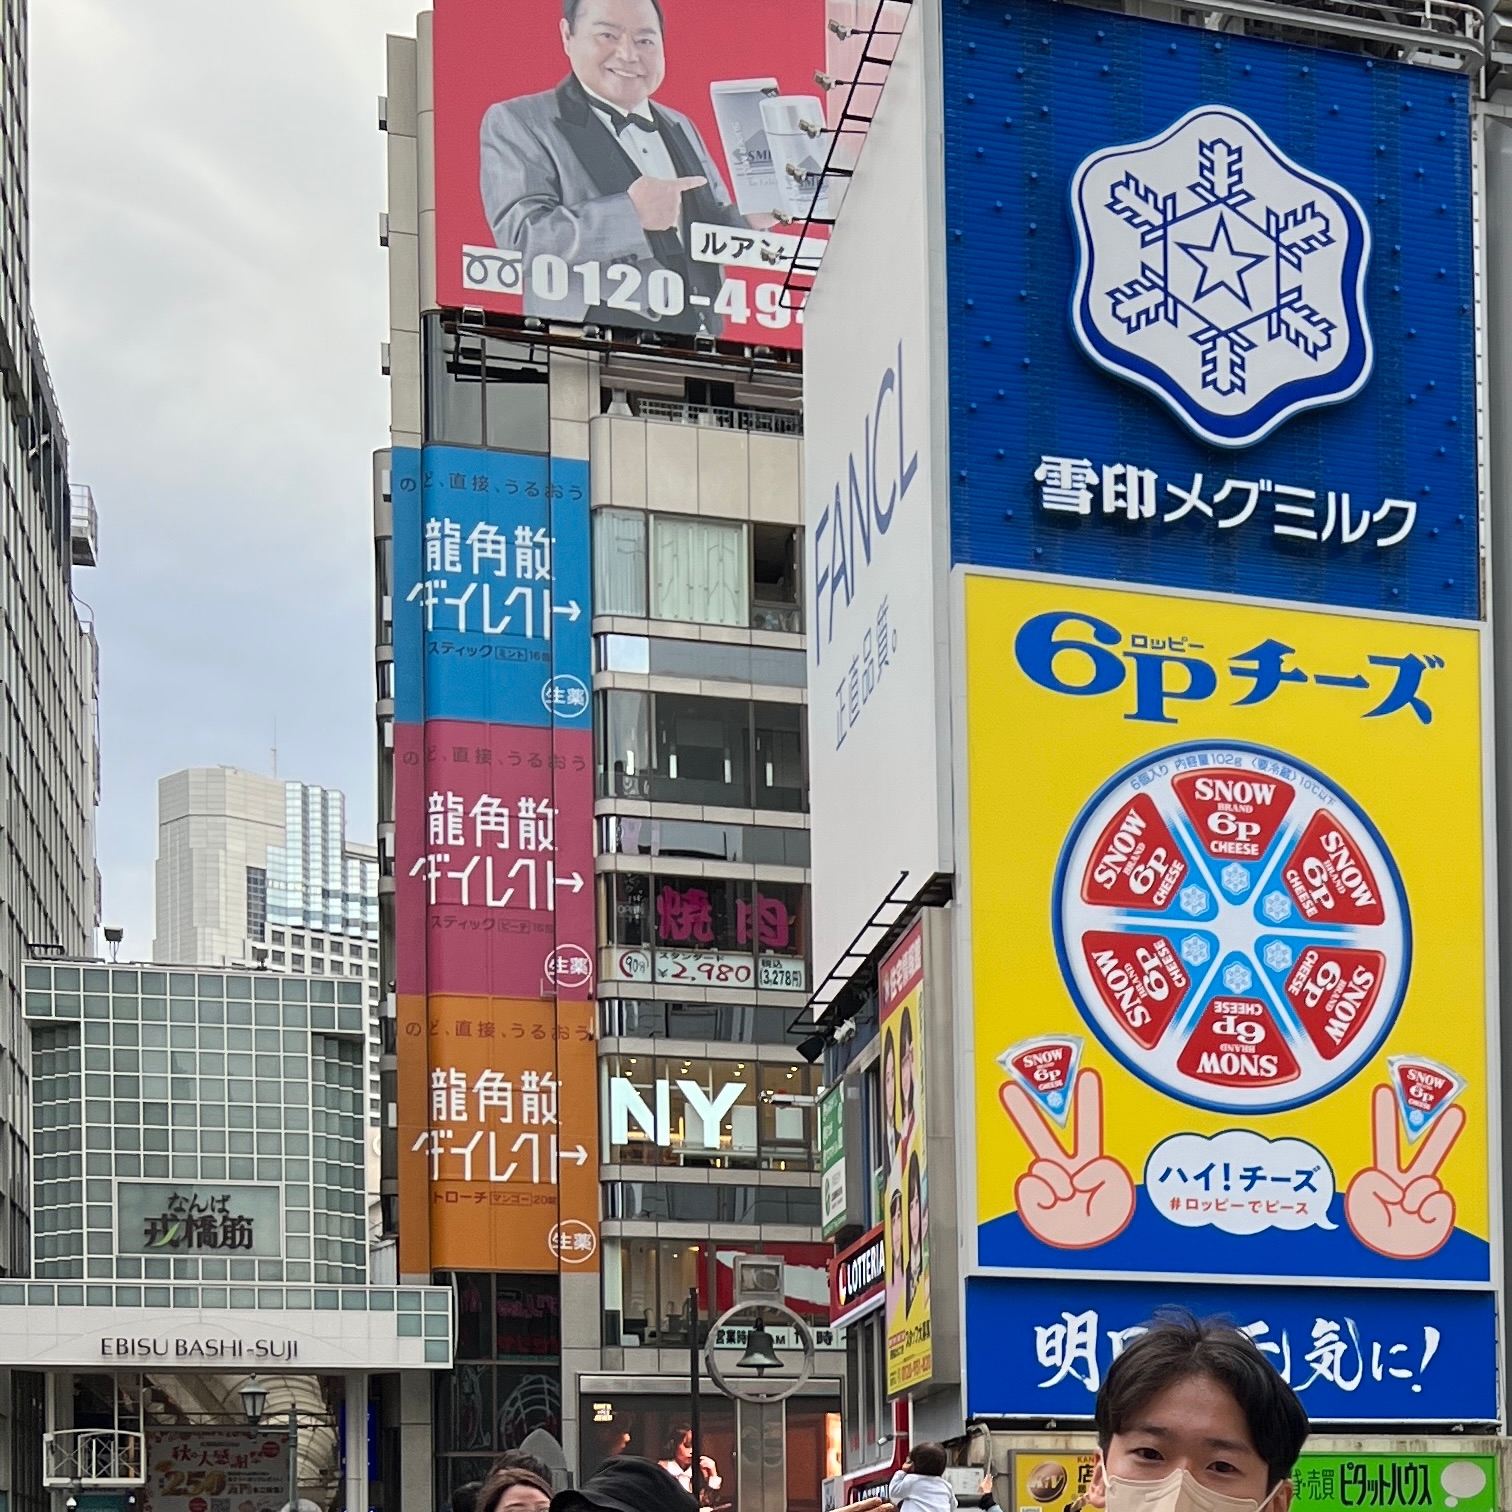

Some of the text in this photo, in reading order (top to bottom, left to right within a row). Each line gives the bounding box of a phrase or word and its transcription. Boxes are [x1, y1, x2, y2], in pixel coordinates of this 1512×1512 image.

[400, 472, 583, 500] のど、直接、うるおう
[814, 338, 918, 667] FANCL
[1034, 455, 1417, 547] 雪印メグミルク
[424, 517, 556, 581] 龍角散
[406, 579, 582, 640] ダイレクト
[428, 641, 493, 658] スティック
[1131, 634, 1204, 652] ロッピー
[546, 687, 585, 706] 生薬
[402, 745, 587, 772] のど、直接、うるおう
[1195, 778, 1277, 806] SNOW
[428, 791, 559, 851] 龍角散
[1093, 809, 1147, 889] SNOW
[1210, 839, 1259, 856] CHEESE
[1321, 831, 1377, 908] SNOW
[409, 853, 584, 911] ダイレクト
[1152, 860, 1185, 906] CHEESE
[1286, 869, 1318, 918] CHEESE
[431, 915, 496, 930] スティック
[657, 884, 789, 948] 焼肉
[549, 956, 589, 975] 生薬
[1153, 939, 1187, 988] CHEESE
[1288, 950, 1319, 996] CHEESE
[1093, 950, 1152, 1028] SNOW
[1214, 1001, 1263, 1015] CHEESE
[1324, 966, 1375, 1046] SNOW
[405, 1020, 592, 1041] のど、直接、うるおう
[1197, 1052, 1278, 1077] SNOW
[431, 1067, 562, 1124] 龍角散
[610, 1077, 747, 1149] NY
[412, 1129, 588, 1184] ダイレクト
[167, 1190, 231, 1213] なんば
[434, 1191, 488, 1204] トローチ
[1170, 1197, 1308, 1216] #ロッピーでピース
[144, 1214, 254, 1250] 戎橋筋
[552, 1233, 592, 1251] 生薬
[847, 1240, 885, 1295] LOTTERIA
[101, 1337, 168, 1356] EBISU
[715, 1329, 753, 1345] 営業時
[1339, 1461, 1433, 1506] ピタットハウス
